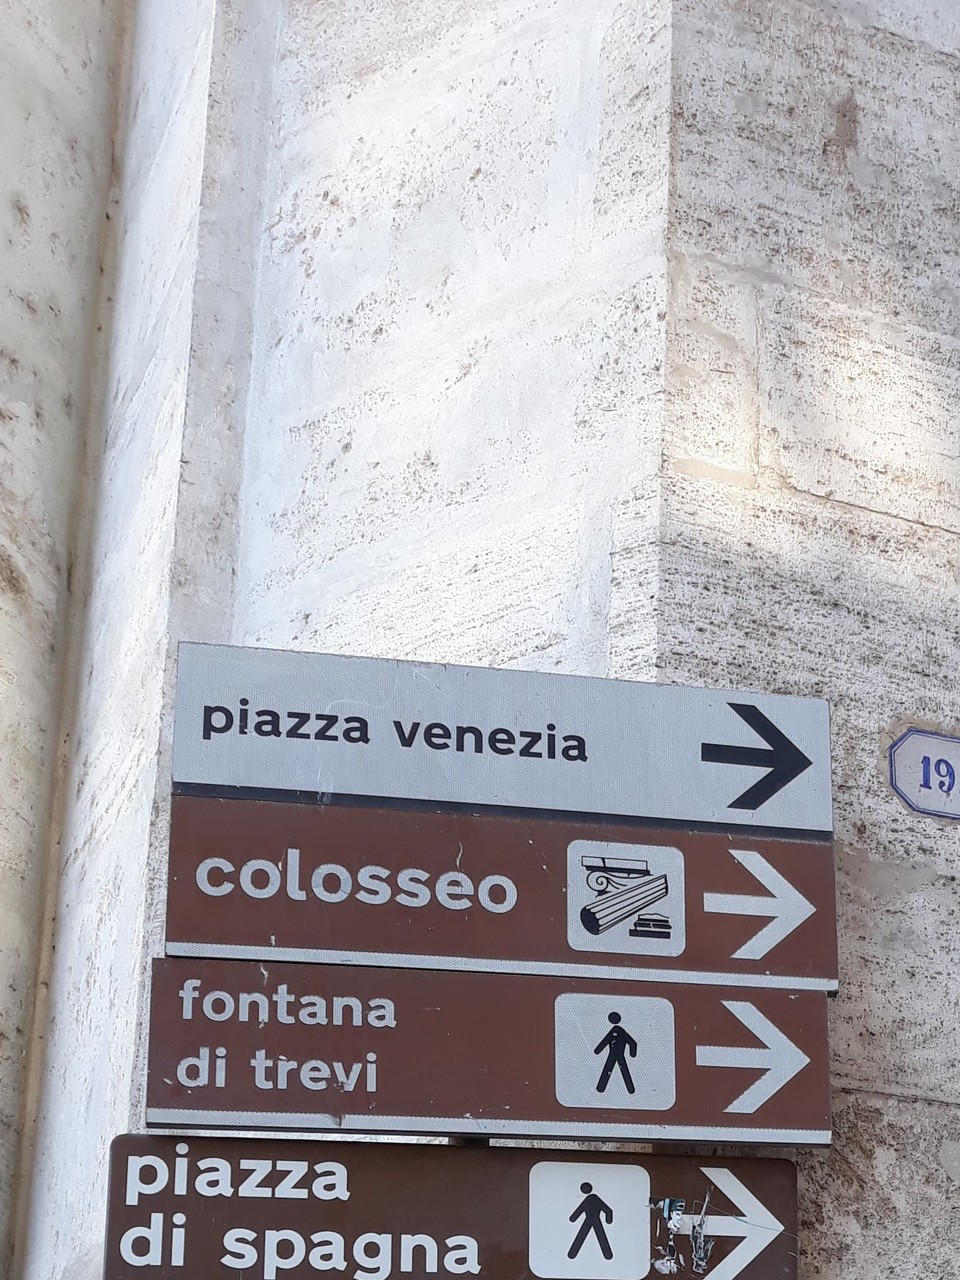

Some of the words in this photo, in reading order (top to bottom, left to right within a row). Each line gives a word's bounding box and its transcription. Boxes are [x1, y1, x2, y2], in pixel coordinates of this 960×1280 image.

[203, 697, 370, 744] piazza
[393, 723, 588, 762] venezia
[195, 848, 518, 914] colosseo
[179, 978, 398, 1029] fontana
[176, 1046, 227, 1088] di
[251, 1051, 378, 1093] trevi
[126, 1142, 351, 1205] piazza
[119, 1213, 187, 1268] di
